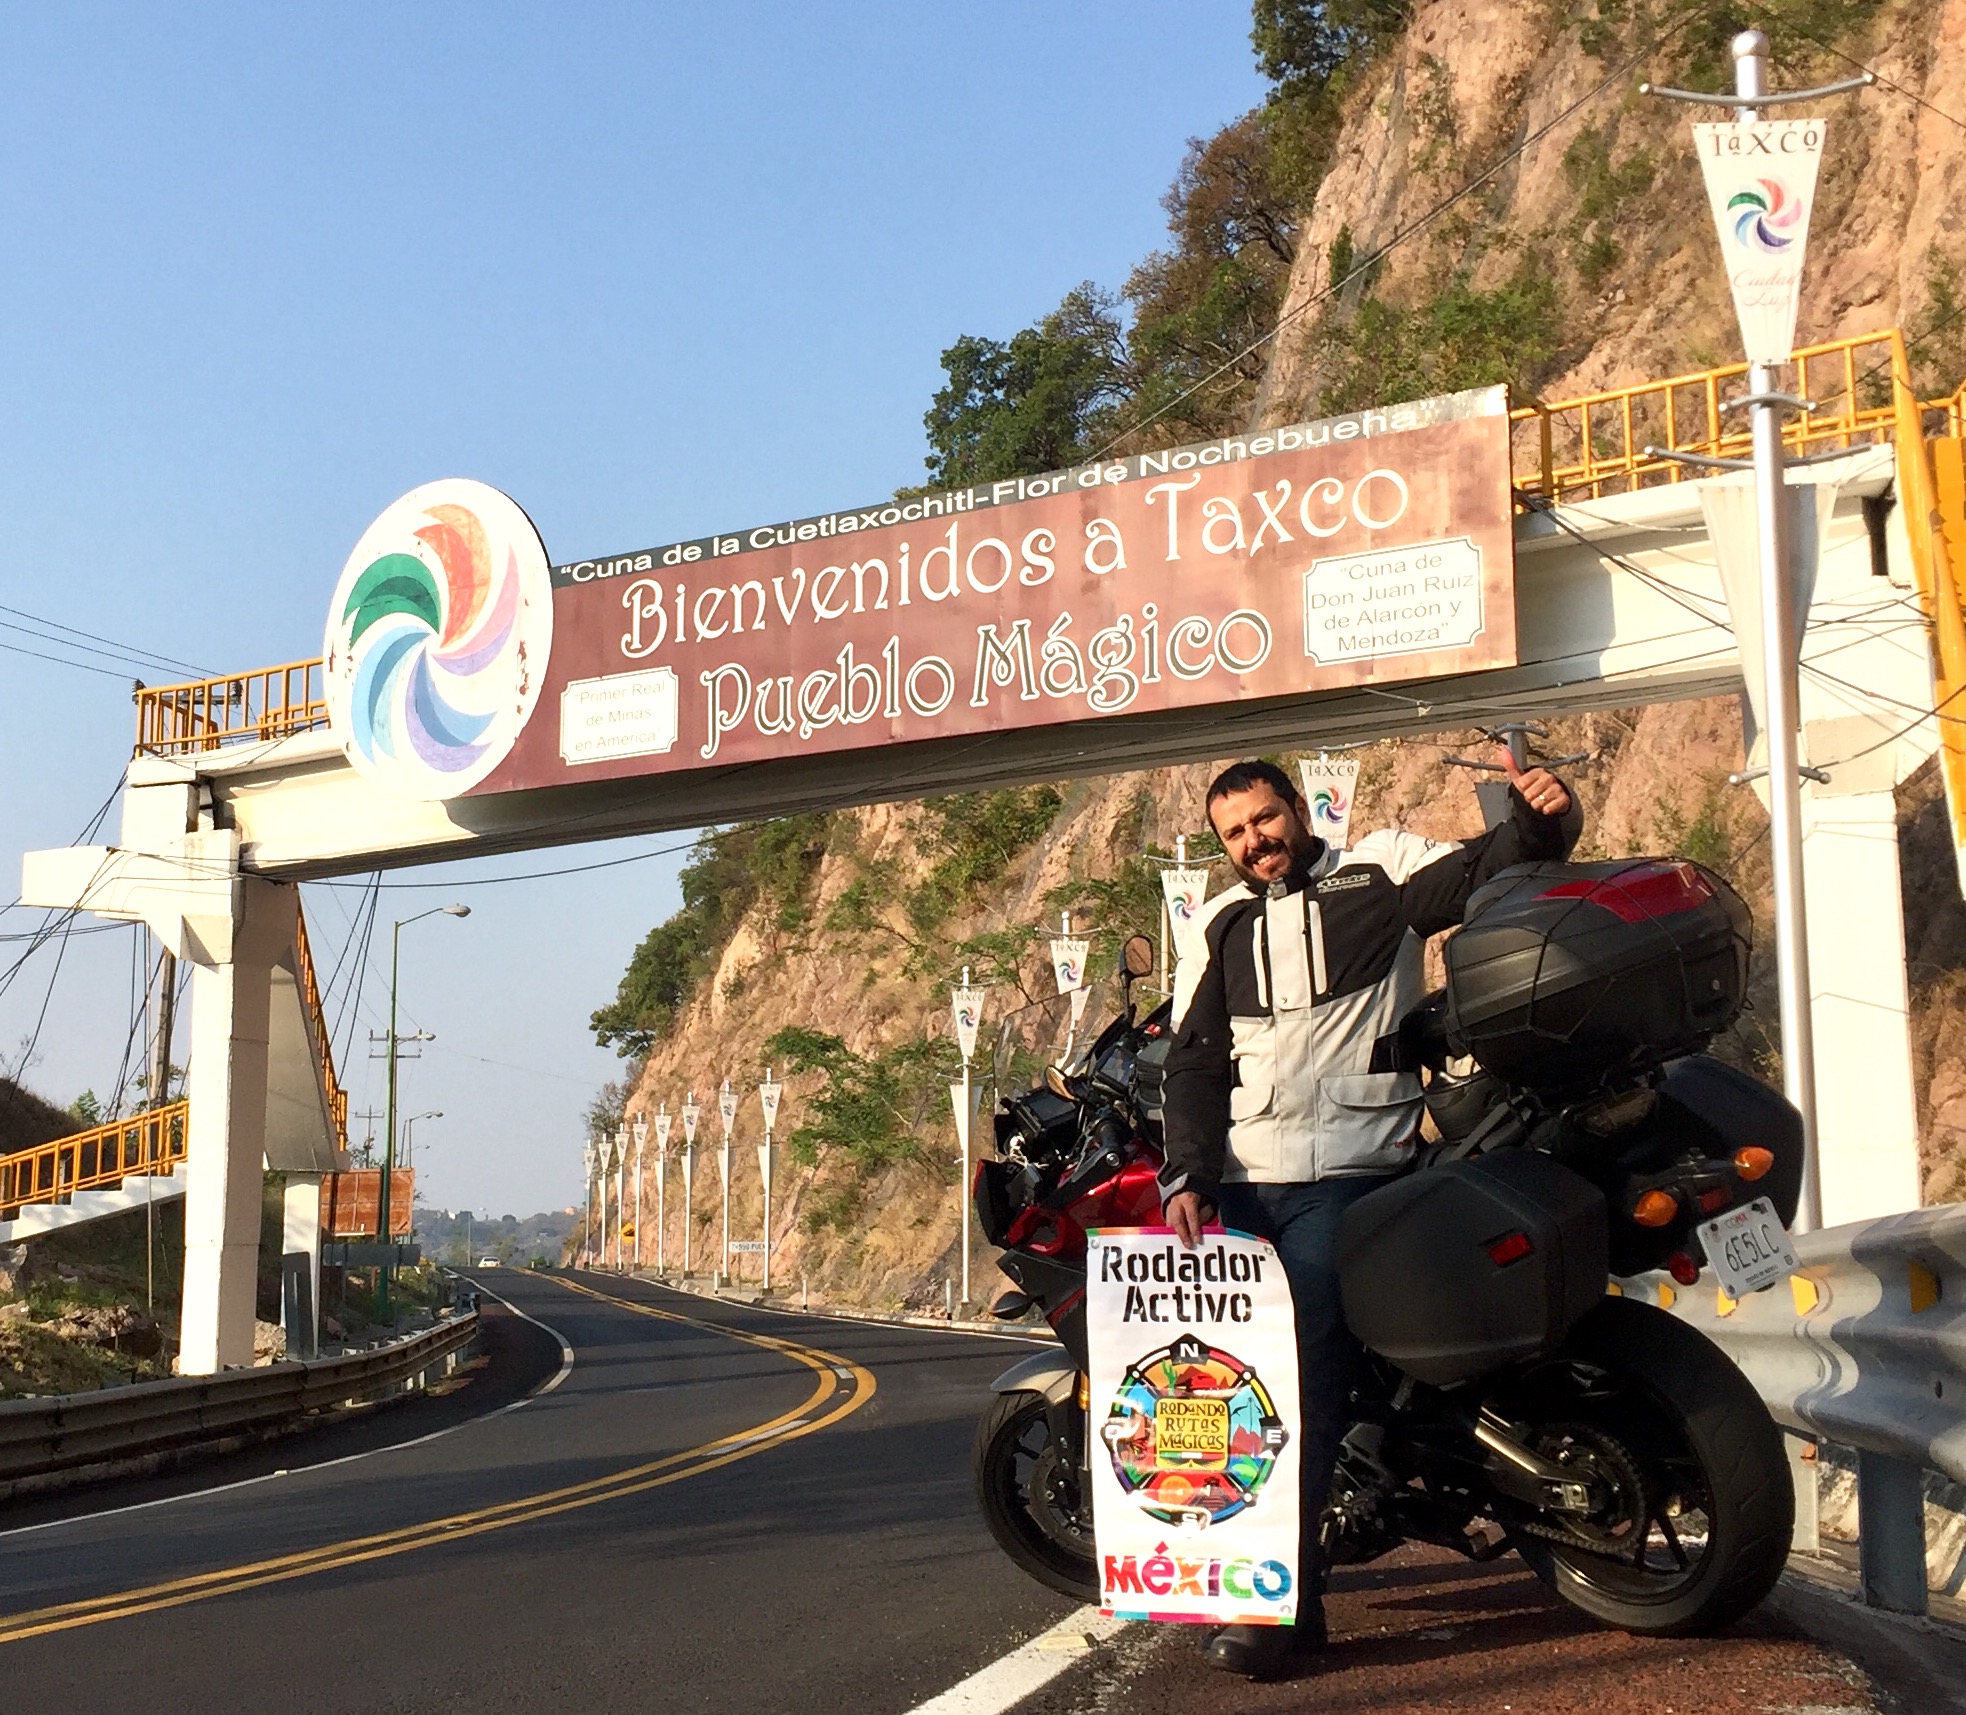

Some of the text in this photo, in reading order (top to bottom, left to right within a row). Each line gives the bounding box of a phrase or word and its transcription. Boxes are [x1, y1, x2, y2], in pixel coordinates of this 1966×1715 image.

[662, 543, 702, 566] de
[712, 536, 740, 557] la
[1077, 463, 1129, 488] de
[620, 468, 1409, 660] Bienvenidos a Taxco
[1414, 552, 1443, 573] de
[1311, 572, 1475, 611] Don Juan Ruiz
[1323, 600, 1463, 631] de Alarcón y
[632, 680, 665, 697] Real
[700, 602, 1273, 760] Pueblo Mágico
[585, 708, 652, 727] de Minas
[575, 740, 592, 752] en
[1100, 1244, 1267, 1284] Rodador
[1724, 1223, 1780, 1273] 6E5LC
[1122, 1283, 1253, 1324] Activo
[1179, 1343, 1199, 1358] N
[1266, 1429, 1282, 1444] E
